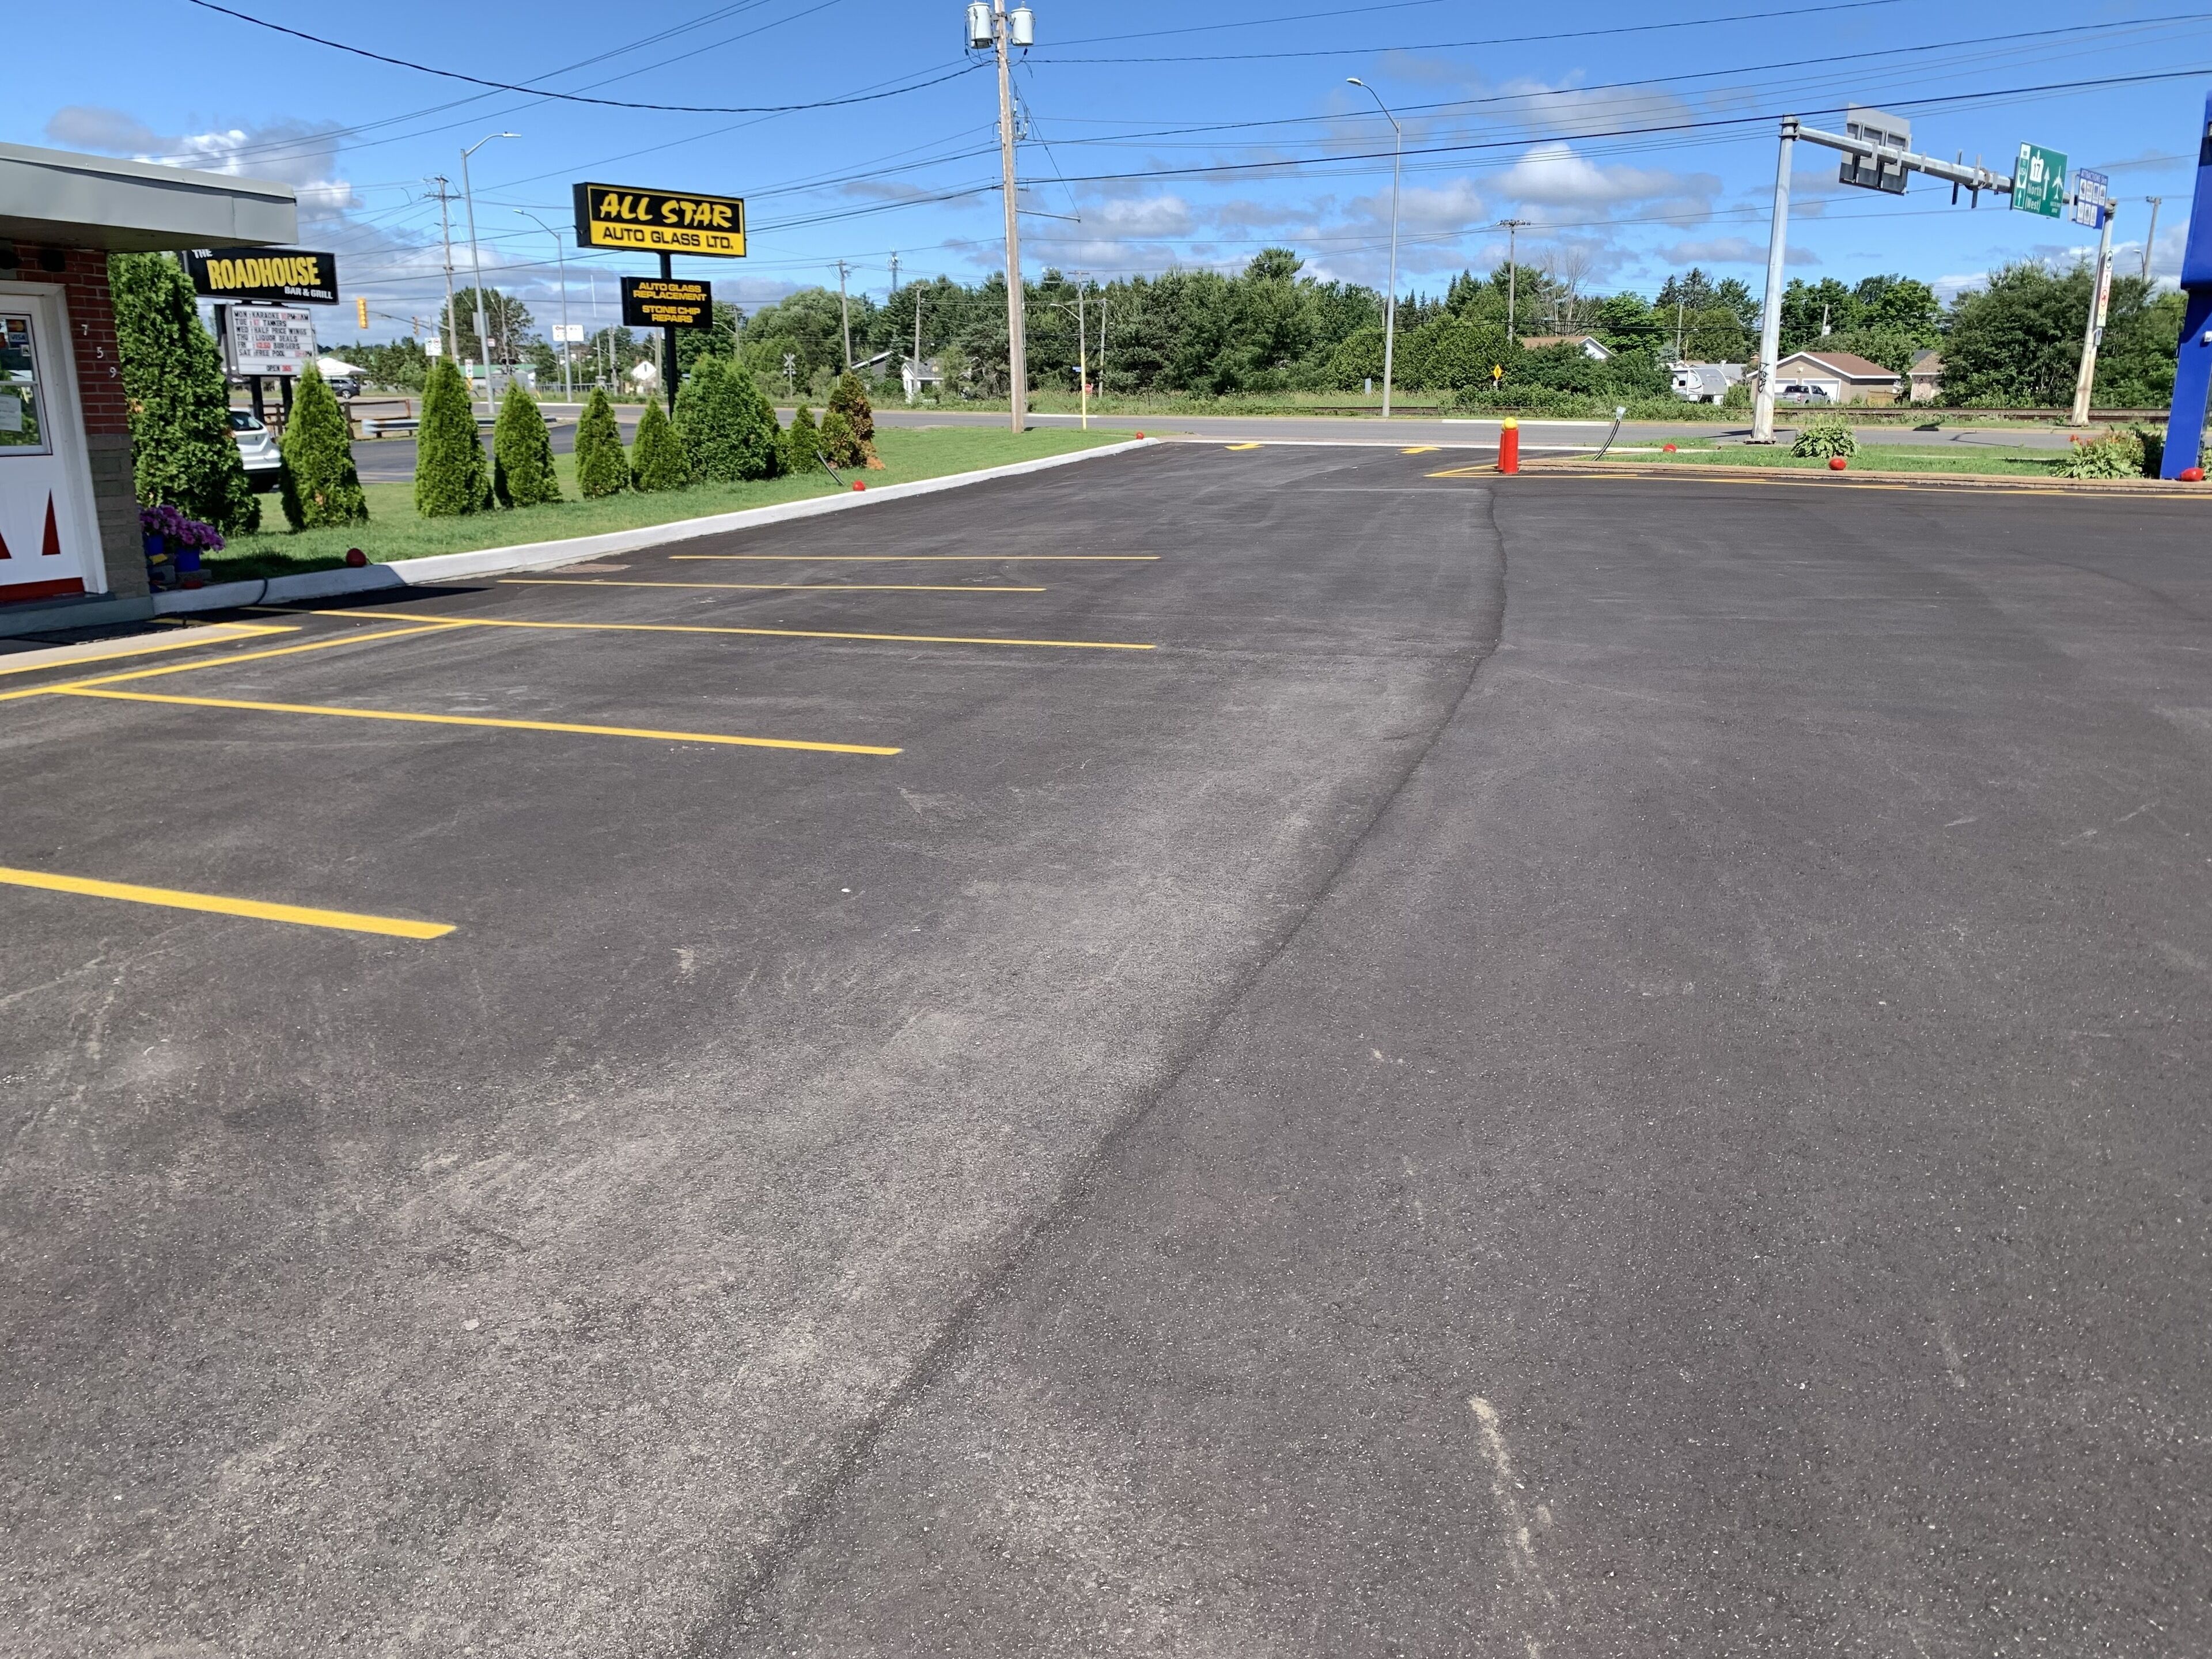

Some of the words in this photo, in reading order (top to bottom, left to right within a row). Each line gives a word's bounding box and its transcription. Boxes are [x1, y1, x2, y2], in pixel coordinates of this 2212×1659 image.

[2033, 163, 2041, 179] 17
[2027, 183, 2042, 197] North
[600, 193, 653, 221] ALL
[661, 200, 733, 229] STAR
[2024, 195, 2041, 213] (West)
[603, 226, 645, 243] AUTO
[651, 230, 700, 247] GLASS
[706, 234, 734, 250] LTD.
[191, 248, 214, 259] THE
[206, 257, 321, 290] ROADHOUSE
[284, 286, 303, 296] BAR
[303, 289, 310, 297] &
[310, 289, 334, 300] GRILL
[638, 282, 668, 291] AUTO
[668, 283, 702, 293] GLASS
[633, 290, 707, 302] REPLACEMENT
[642, 305, 677, 315] STONE
[677, 306, 701, 316] CHIP
[652, 314, 694, 323] REPAIRS
